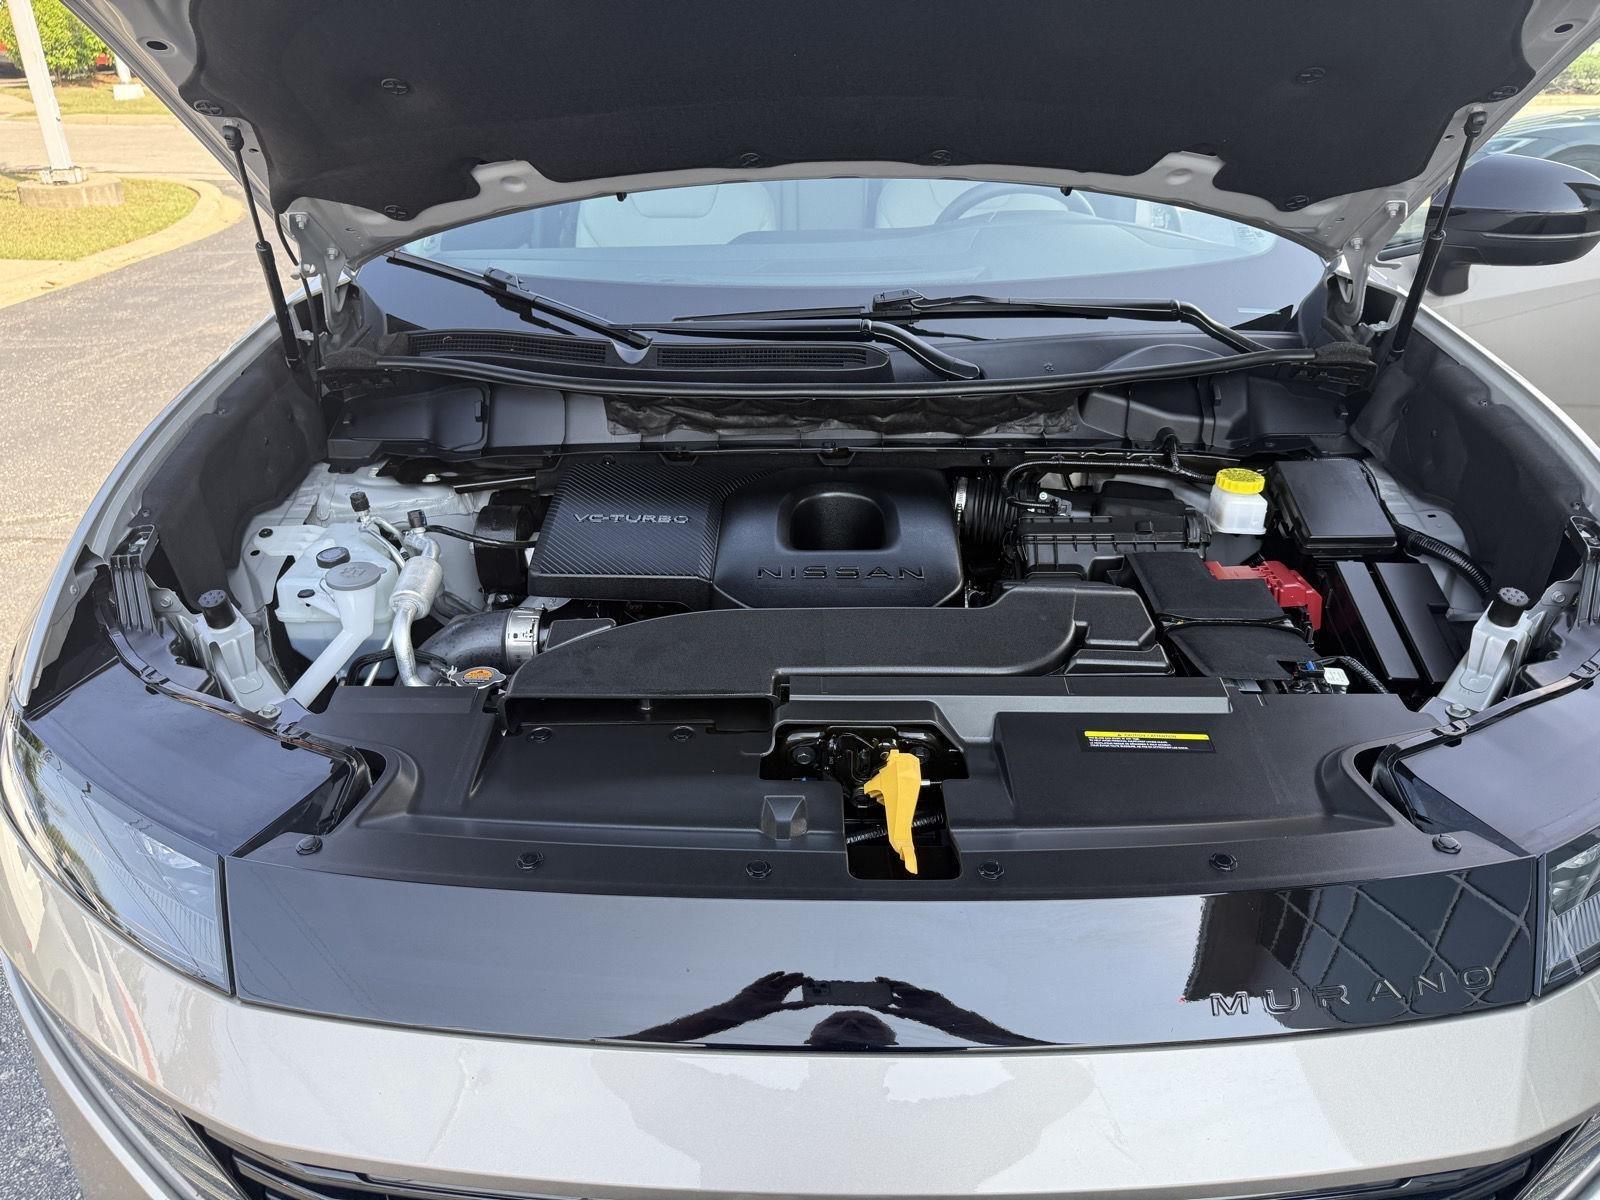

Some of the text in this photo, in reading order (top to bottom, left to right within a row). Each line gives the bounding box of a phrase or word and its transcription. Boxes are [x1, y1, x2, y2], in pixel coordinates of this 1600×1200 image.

[573, 513, 690, 524] VC-TURBO
[757, 565, 926, 580] NISSAN
[1209, 965, 1494, 1017] MURANO
